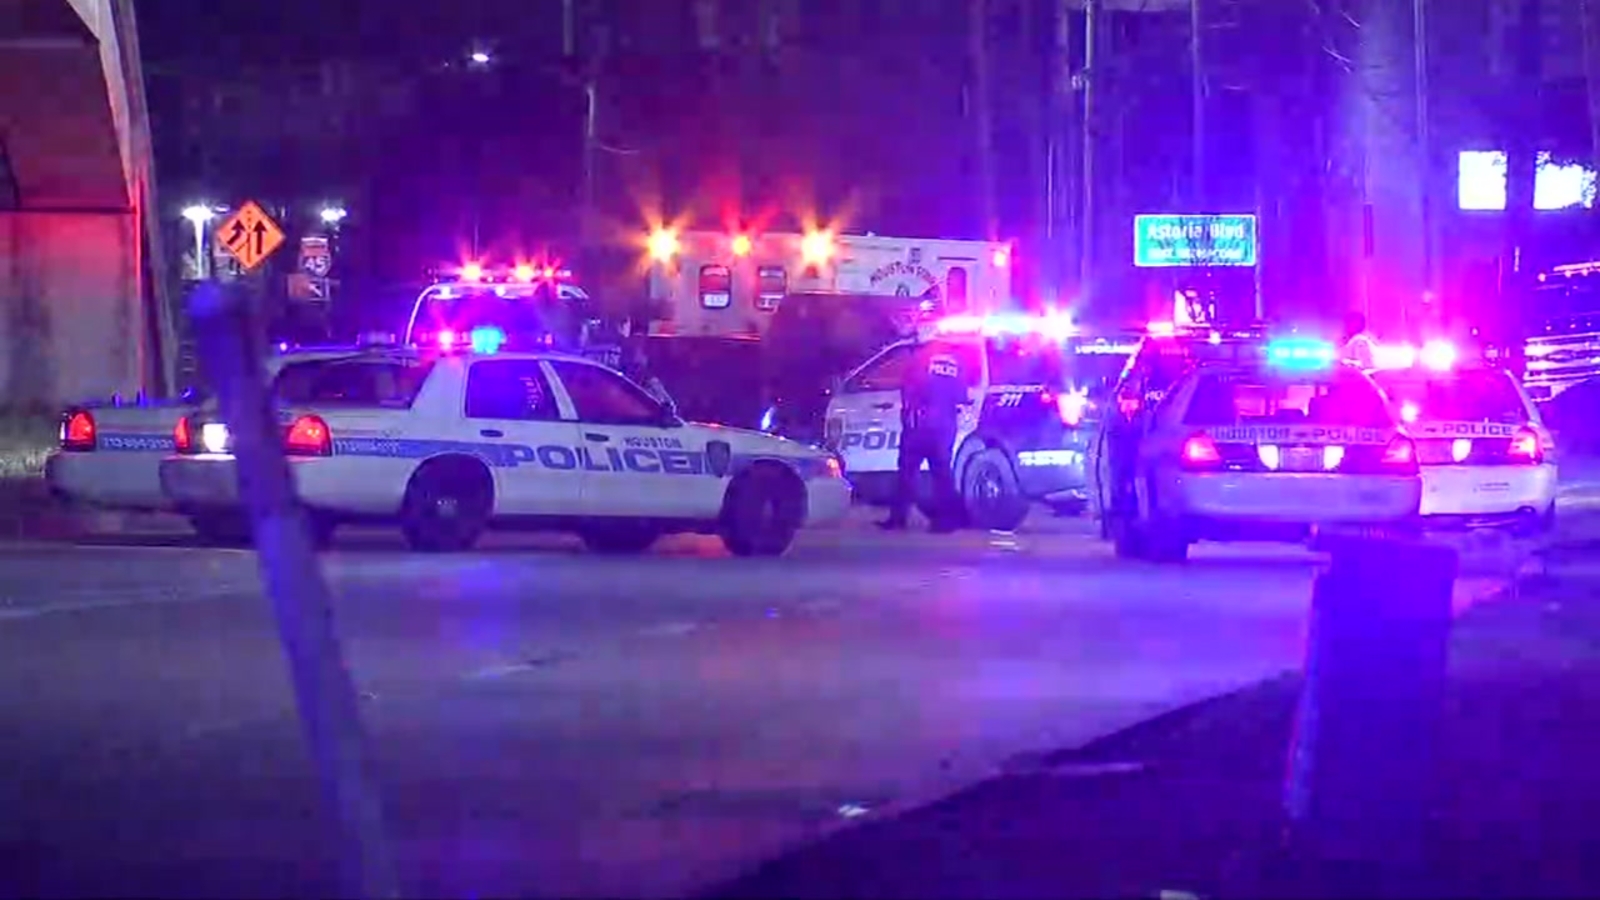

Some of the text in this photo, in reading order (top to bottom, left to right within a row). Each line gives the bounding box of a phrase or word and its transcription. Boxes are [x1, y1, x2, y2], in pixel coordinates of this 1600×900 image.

[1147, 222, 1202, 239] Astoria
[304, 257, 326, 274] 45
[928, 363, 957, 378] POLICE
[1443, 424, 1512, 436] POLICE
[623, 436, 682, 449] HOUSTON
[841, 431, 899, 450] POL
[497, 445, 702, 475] POLICE
